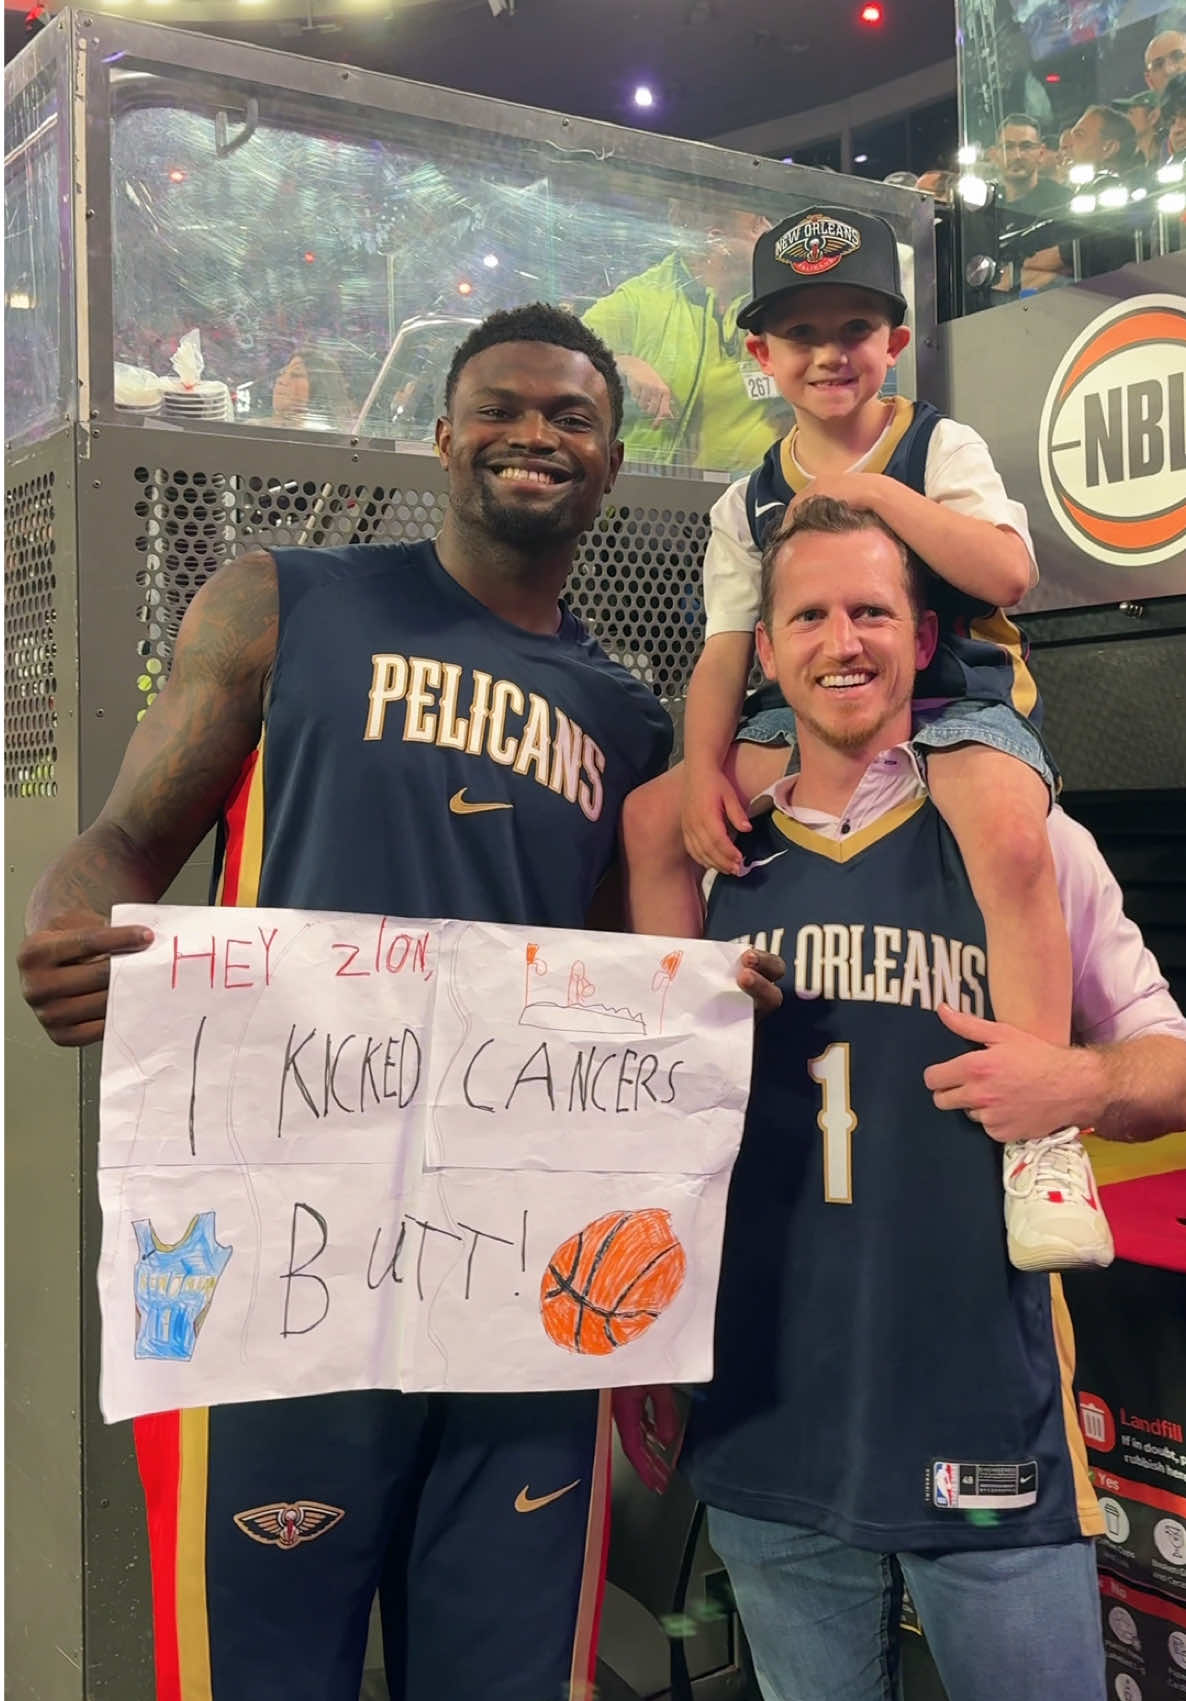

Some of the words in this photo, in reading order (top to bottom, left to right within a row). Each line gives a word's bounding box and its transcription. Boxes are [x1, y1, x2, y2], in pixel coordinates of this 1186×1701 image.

[776, 228, 801, 258] NEW
[804, 221, 860, 246] ORLEANS
[748, 376, 770, 397] 267
[1084, 371, 1186, 488] NBL
[363, 653, 606, 822] PELICANS
[171, 928, 279, 989] HEY
[795, 923, 986, 1019] ORLEANS
[189, 1016, 206, 1156] I
[278, 1024, 423, 1138] KICKED
[463, 1038, 685, 1113] CANCERS
[807, 1042, 858, 1204] 1
[1120, 1408, 1184, 1443] Landfill
[1098, 1472, 1120, 1491] Yes
